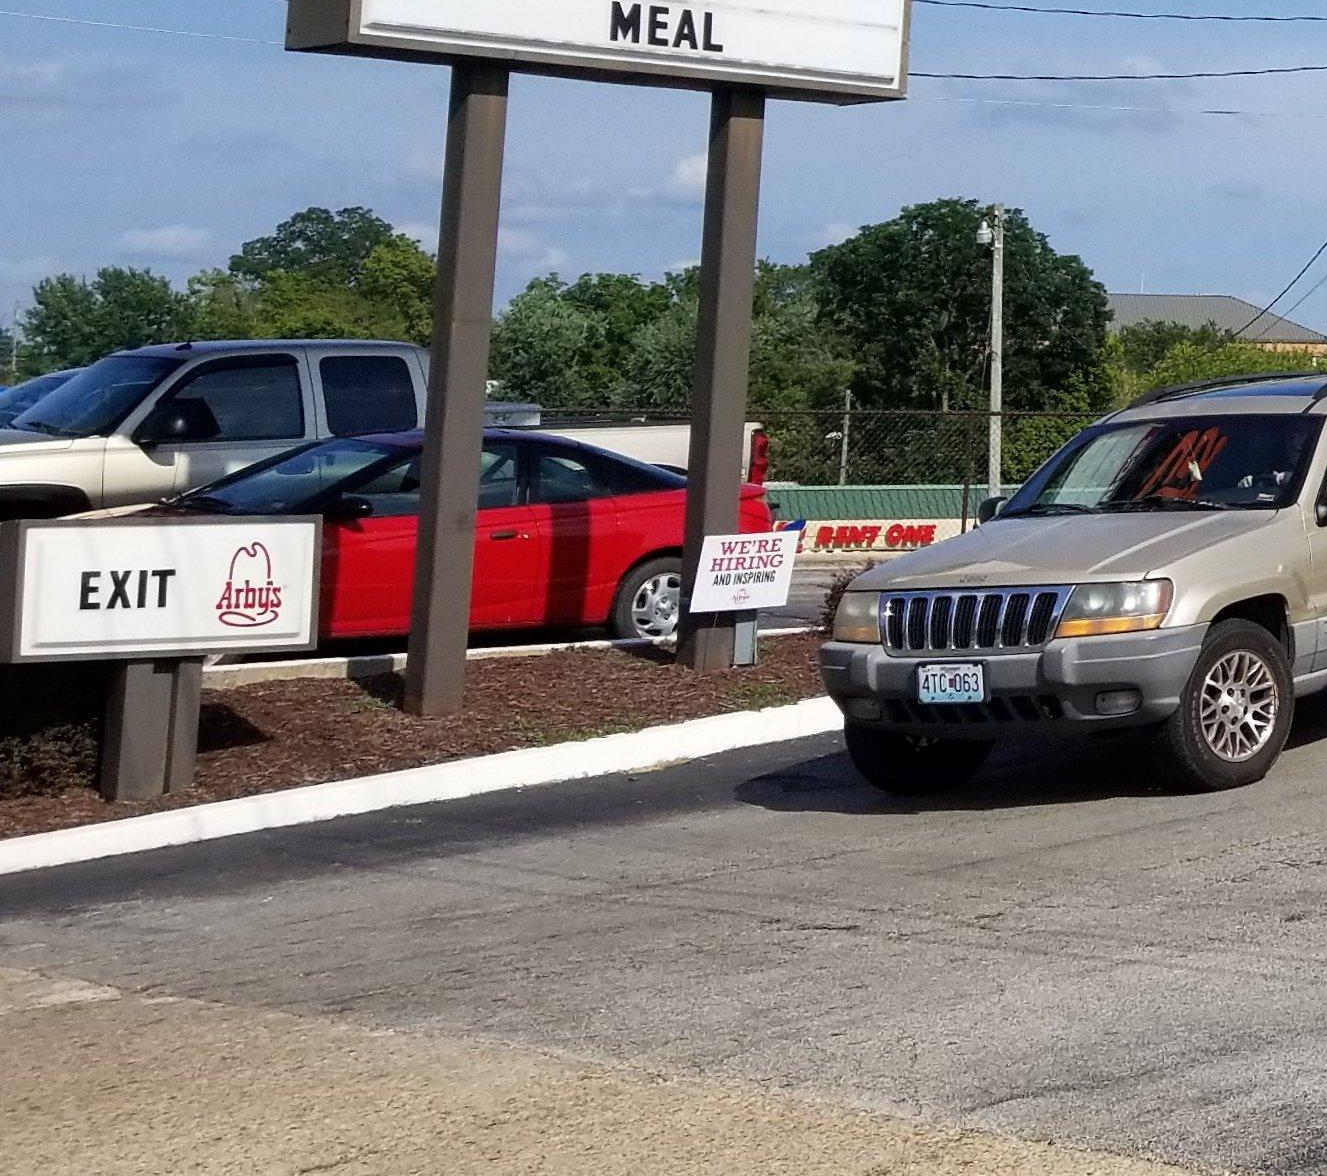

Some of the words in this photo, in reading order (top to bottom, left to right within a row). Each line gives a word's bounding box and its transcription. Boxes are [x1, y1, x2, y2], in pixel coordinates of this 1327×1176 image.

[609, 0, 725, 54] MEAL
[721, 538, 783, 556] WE'RE
[814, 525, 882, 550] RENT
[884, 523, 937, 549] ONE
[709, 554, 784, 573] HIRING
[712, 573, 732, 587] AND
[732, 569, 777, 586] INSPIRING
[78, 568, 177, 611] EXIT
[215, 578, 283, 616] Arby's
